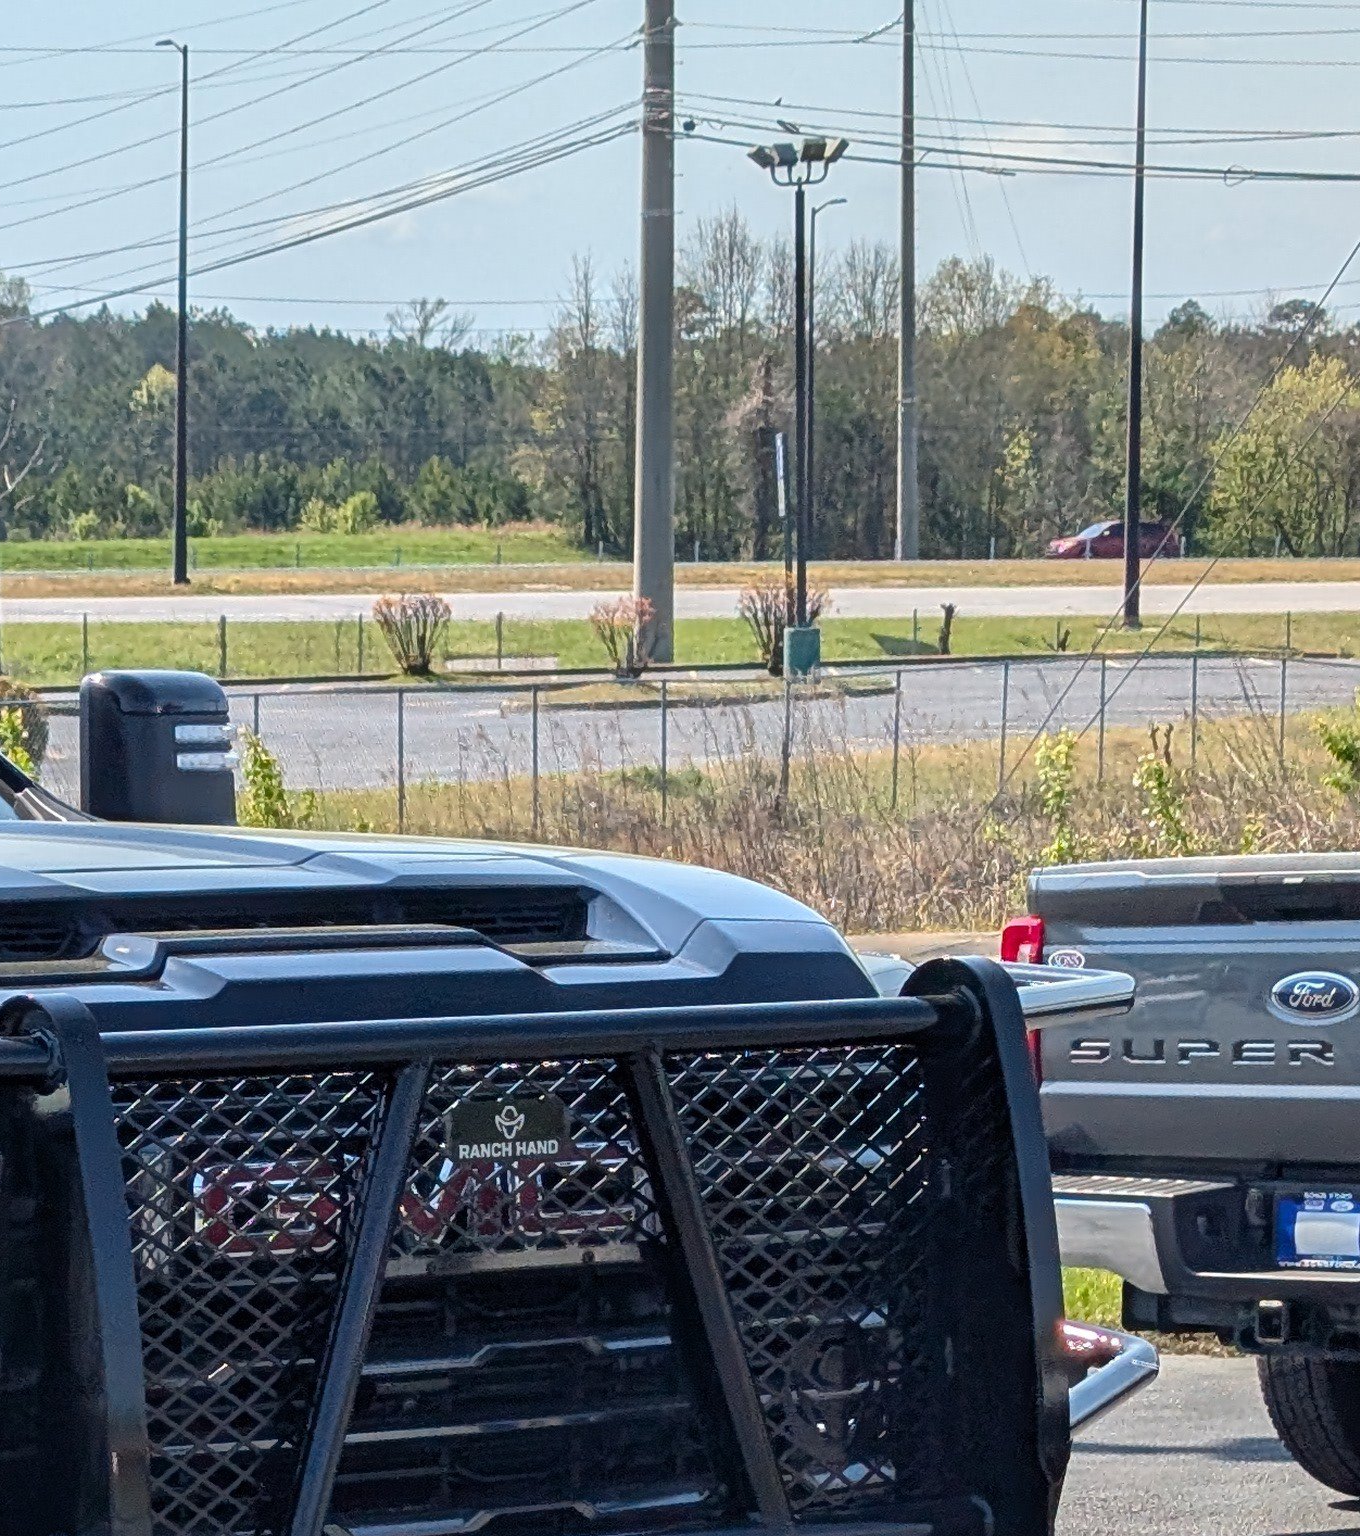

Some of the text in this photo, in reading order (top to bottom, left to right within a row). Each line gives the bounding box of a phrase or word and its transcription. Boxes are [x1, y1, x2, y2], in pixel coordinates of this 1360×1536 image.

[1289, 981, 1337, 1008] Ford
[1070, 1038, 1335, 1066] SUPER
[458, 1139, 559, 1159] RANCH HAND
